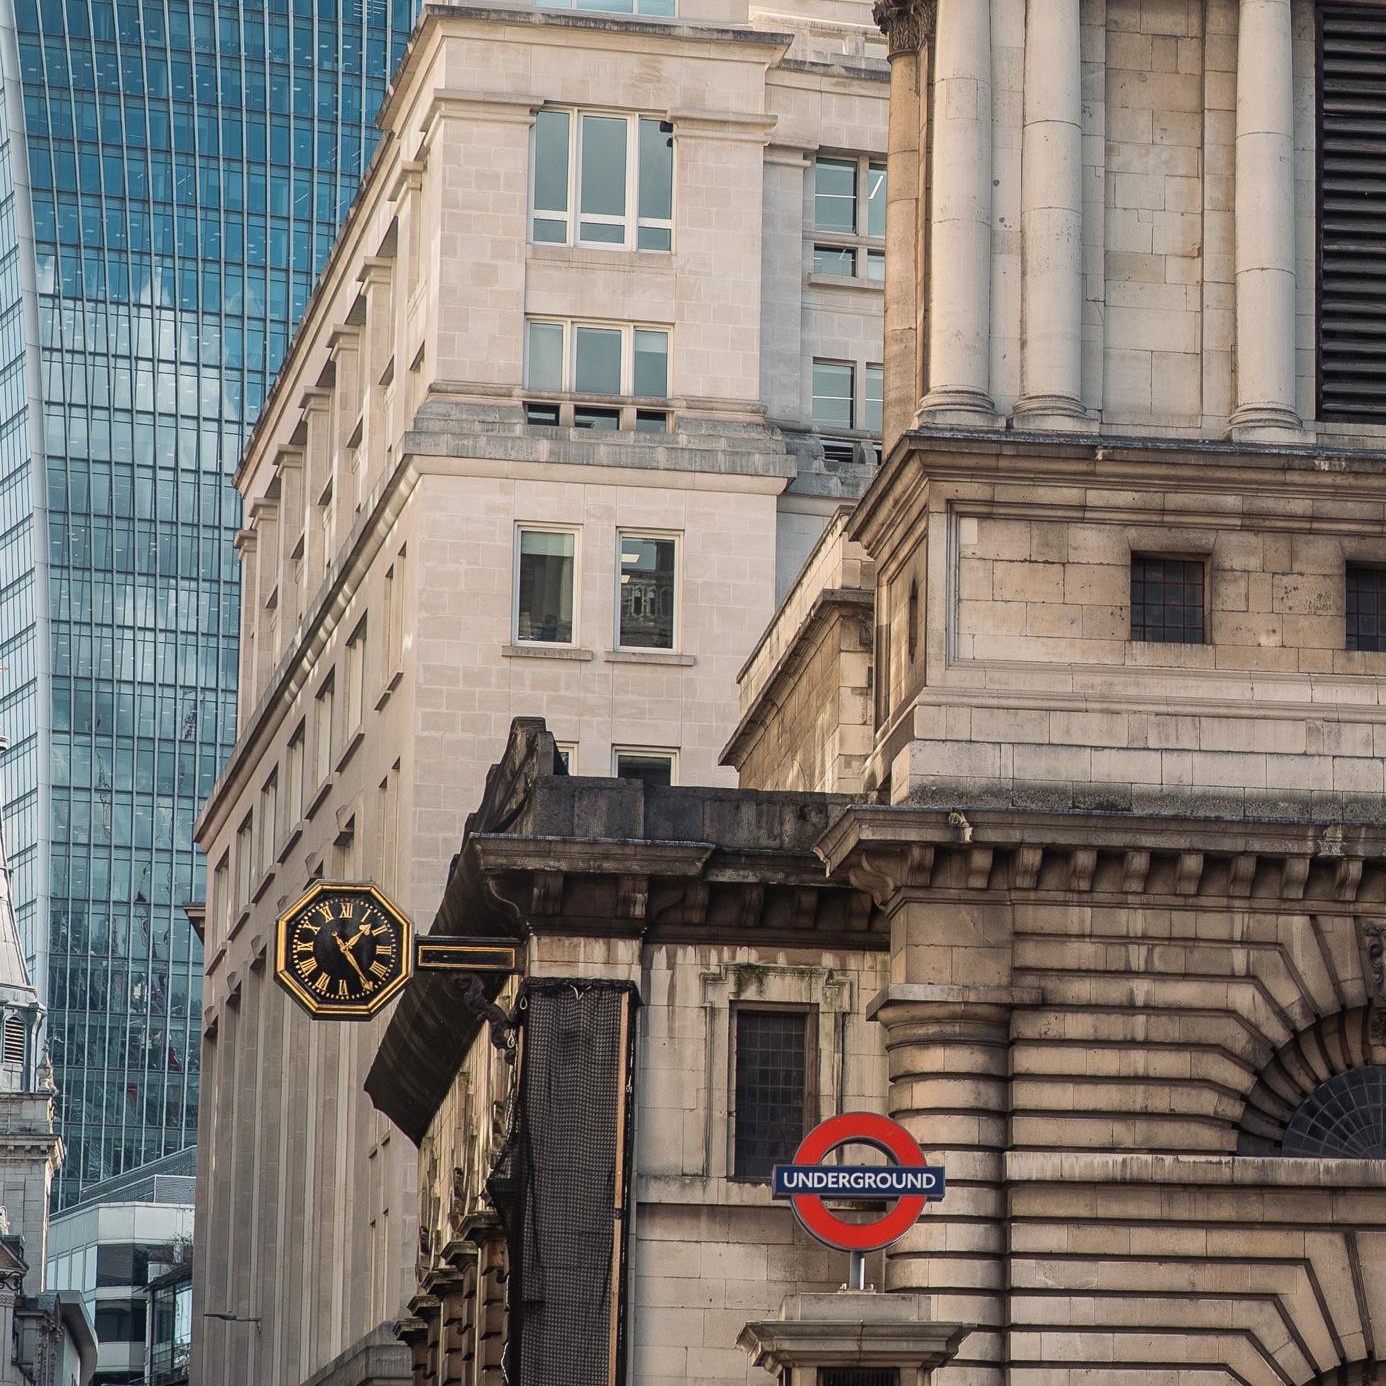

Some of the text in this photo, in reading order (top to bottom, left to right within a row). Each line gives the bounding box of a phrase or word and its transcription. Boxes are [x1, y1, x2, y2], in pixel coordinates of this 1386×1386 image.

[319, 906, 334, 923] XI
[339, 902, 353, 918] XII
[361, 909, 372, 923] I
[303, 920, 321, 935] X
[371, 924, 388, 937] II
[296, 941, 314, 952] IX
[376, 945, 392, 955] III
[338, 979, 348, 996] VI
[783, 1172, 936, 1189] UNDERGROUND
